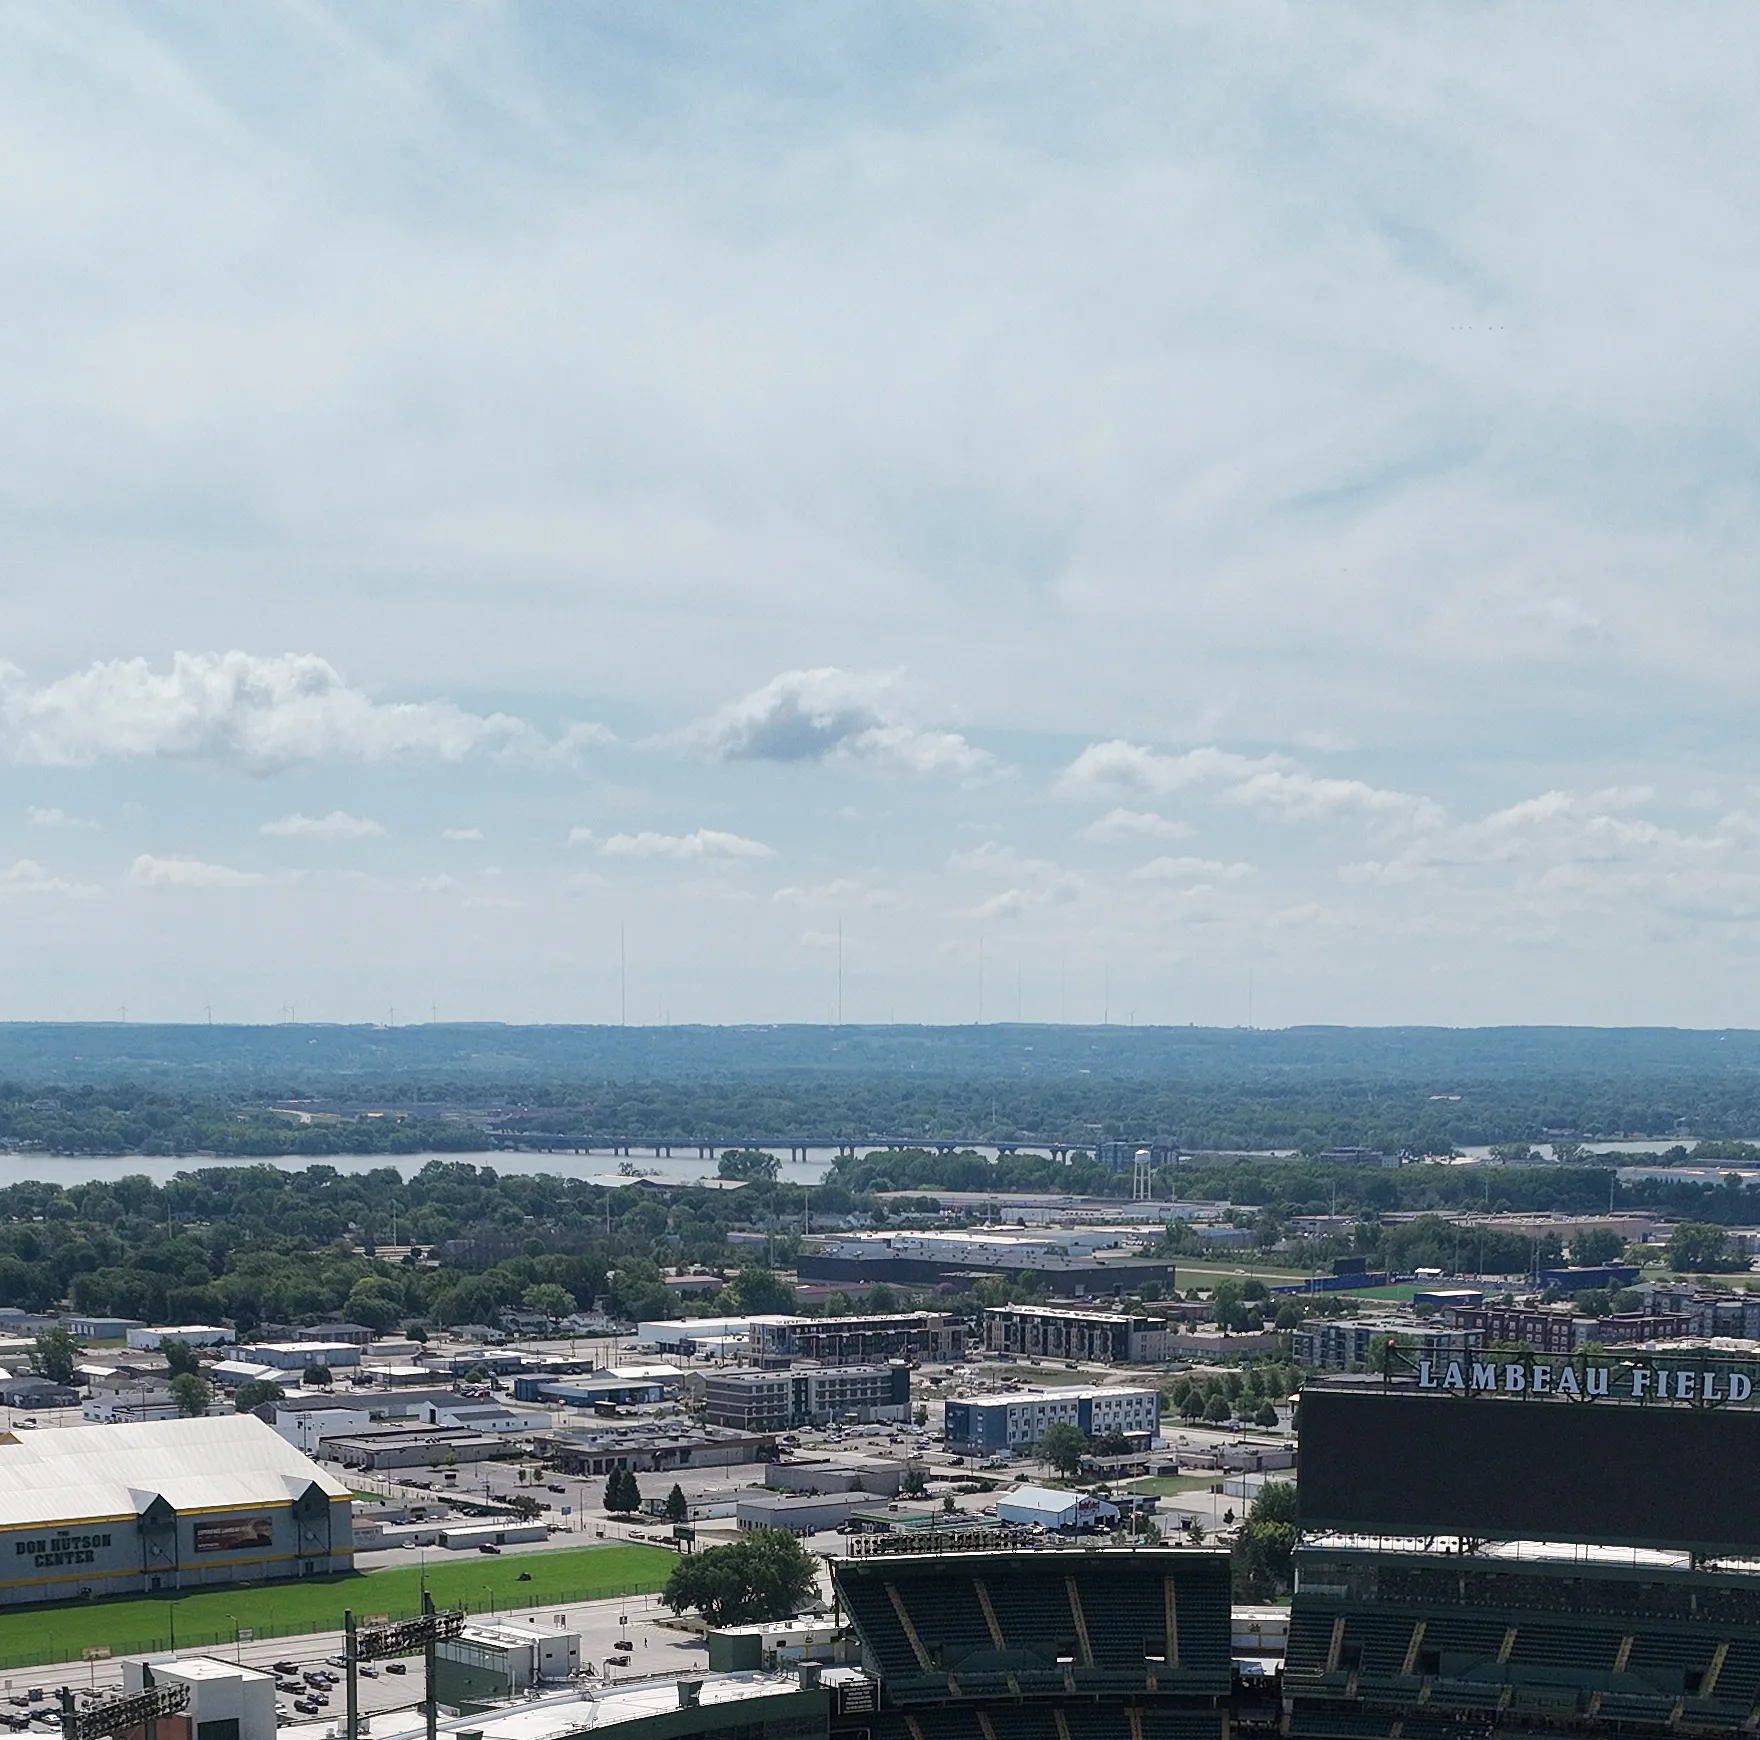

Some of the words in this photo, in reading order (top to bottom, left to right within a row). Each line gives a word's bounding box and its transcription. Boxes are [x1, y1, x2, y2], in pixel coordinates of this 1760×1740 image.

[1418, 1360, 1609, 1396] LAMBEAU
[1631, 1369, 1753, 1401] FIELD
[15, 1539, 47, 1556] DON
[51, 1533, 112, 1552] HUTSON
[34, 1549, 95, 1568] CENTER
